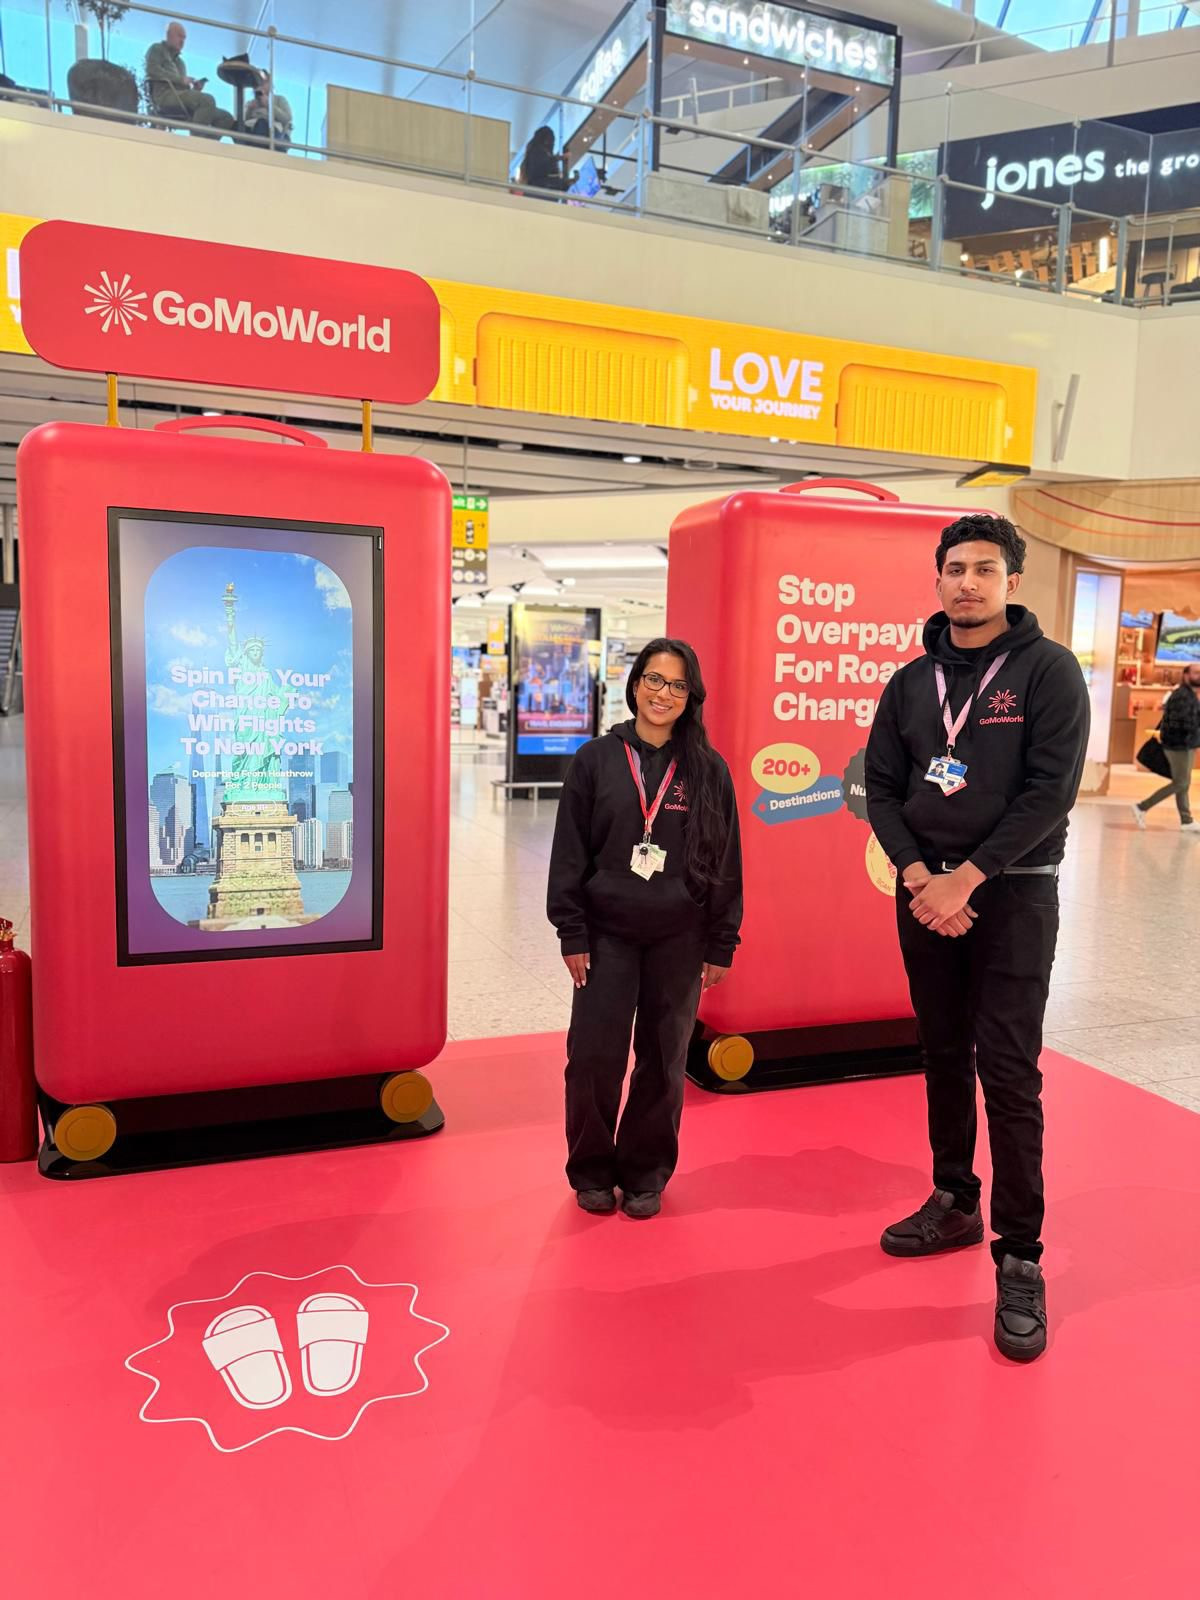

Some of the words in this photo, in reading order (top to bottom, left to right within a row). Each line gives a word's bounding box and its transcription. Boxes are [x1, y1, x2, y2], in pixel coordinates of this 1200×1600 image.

[689, 0, 878, 71] sandwiches
[980, 150, 1106, 210] jones
[1114, 158, 1150, 177] the
[1159, 153, 1200, 176] gro
[152, 290, 391, 353] GoMoWorld
[709, 347, 824, 402] LOVE
[710, 393, 752, 412] YOUR
[754, 398, 821, 420] JOURNEY
[778, 574, 855, 613] Stop
[776, 613, 924, 652] Overpayi
[170, 664, 223, 687] Spin
[228, 667, 269, 685] For
[275, 669, 331, 688] Your
[774, 653, 833, 683] For
[837, 653, 908, 684] Roa
[191, 690, 281, 709] Chance
[284, 692, 312, 710] To
[773, 692, 880, 728] Charg
[188, 713, 235, 732] Win
[239, 715, 317, 737] Flights
[979, 715, 1025, 725] GoMoWorld
[180, 737, 210, 755] To
[214, 737, 266, 756] New
[270, 738, 325, 756] York
[192, 769, 240, 780] Departing
[241, 770, 267, 778] From
[269, 769, 313, 778] Heathrow
[762, 758, 811, 777] 200+
[225, 781, 241, 789] For
[251, 781, 282, 791] People
[769, 789, 841, 811] Destinations
